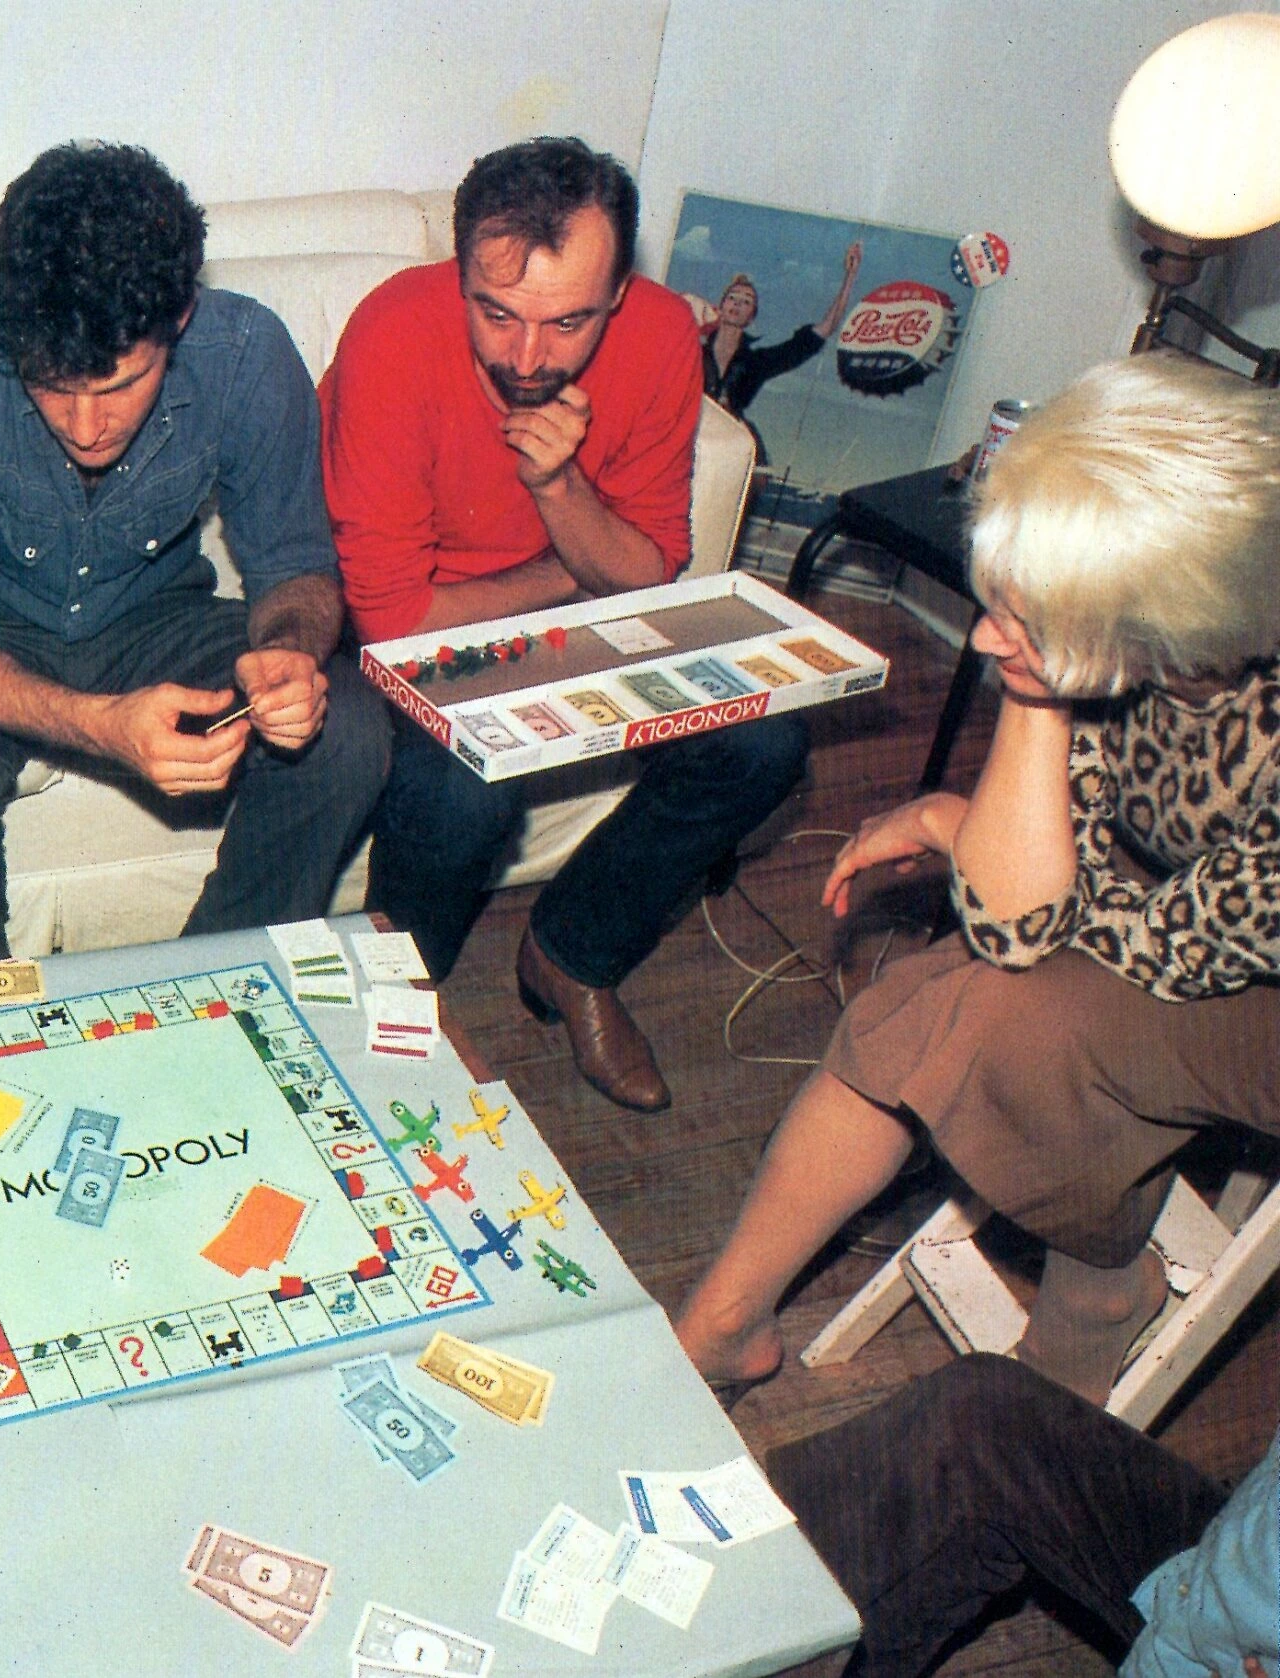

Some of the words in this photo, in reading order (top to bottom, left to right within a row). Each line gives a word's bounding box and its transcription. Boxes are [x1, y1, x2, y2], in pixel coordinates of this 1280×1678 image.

[366, 655, 449, 740] MONOPOLY
[630, 695, 767, 746] MONOPOLY
[83, 1181, 101, 1198] 50
[426, 1265, 459, 1297] GO
[463, 1368, 497, 1390] 100
[387, 1418, 410, 1440] 50
[258, 1567, 271, 1583] 5
[415, 1646, 425, 1662] 1
